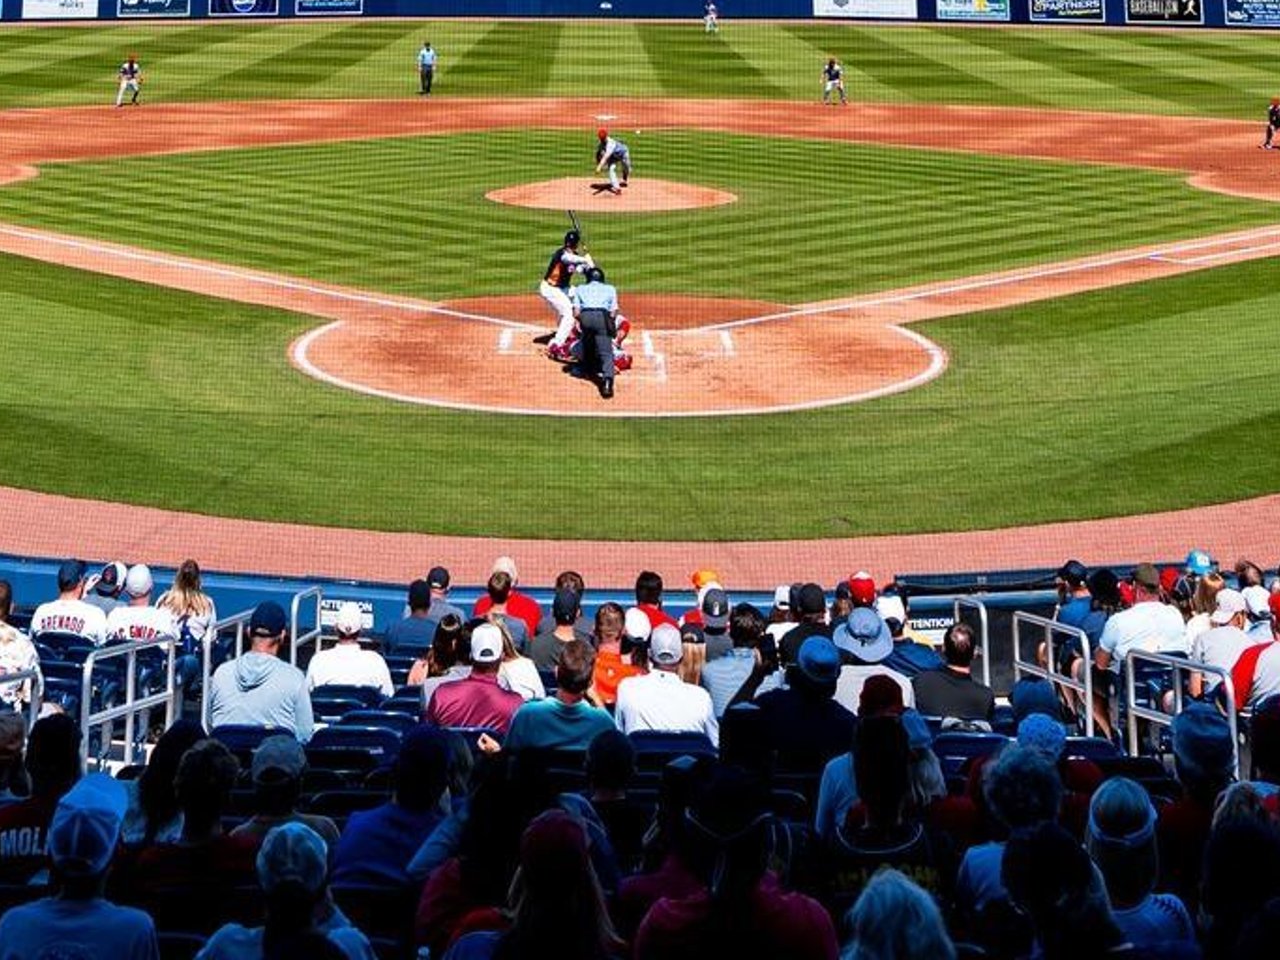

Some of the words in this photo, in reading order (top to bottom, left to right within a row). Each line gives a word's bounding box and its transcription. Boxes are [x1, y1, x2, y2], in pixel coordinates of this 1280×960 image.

[1042, 0, 1100, 11] PARTNERS
[40, 614, 86, 634] ARENADO
[907, 617, 954, 629] TENTION
[0, 826, 49, 856] MOL
